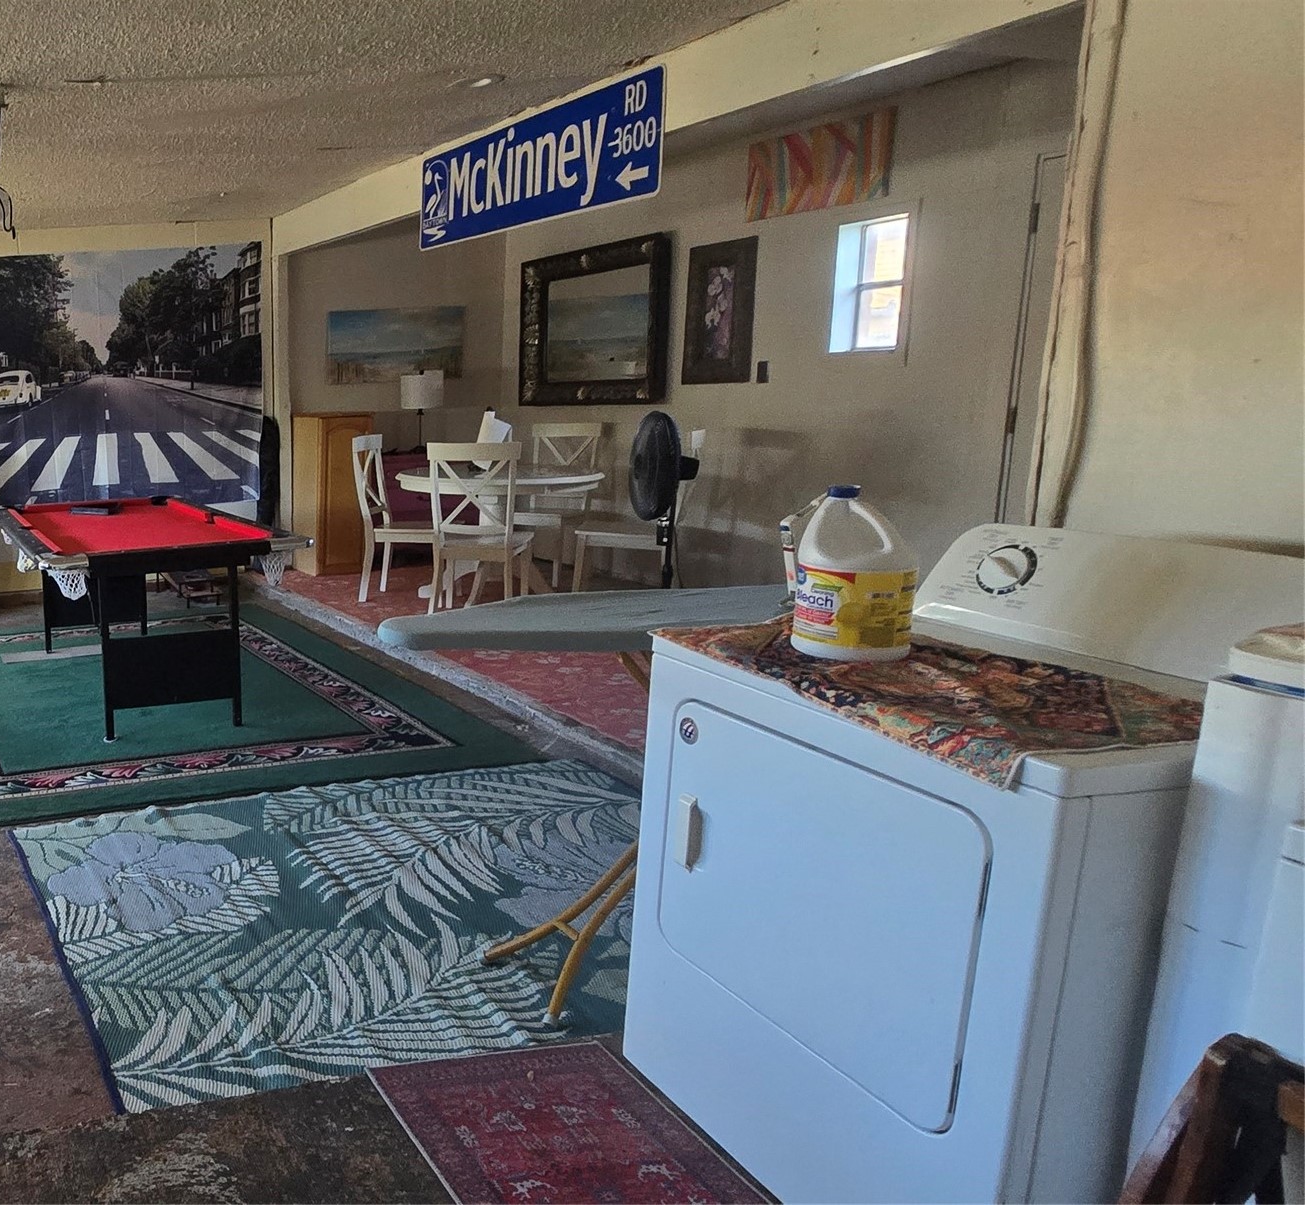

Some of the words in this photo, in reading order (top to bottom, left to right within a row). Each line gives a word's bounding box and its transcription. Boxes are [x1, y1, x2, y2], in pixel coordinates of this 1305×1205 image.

[623, 79, 648, 116] RD
[612, 115, 658, 159] 3600
[448, 111, 608, 221] McKinney
